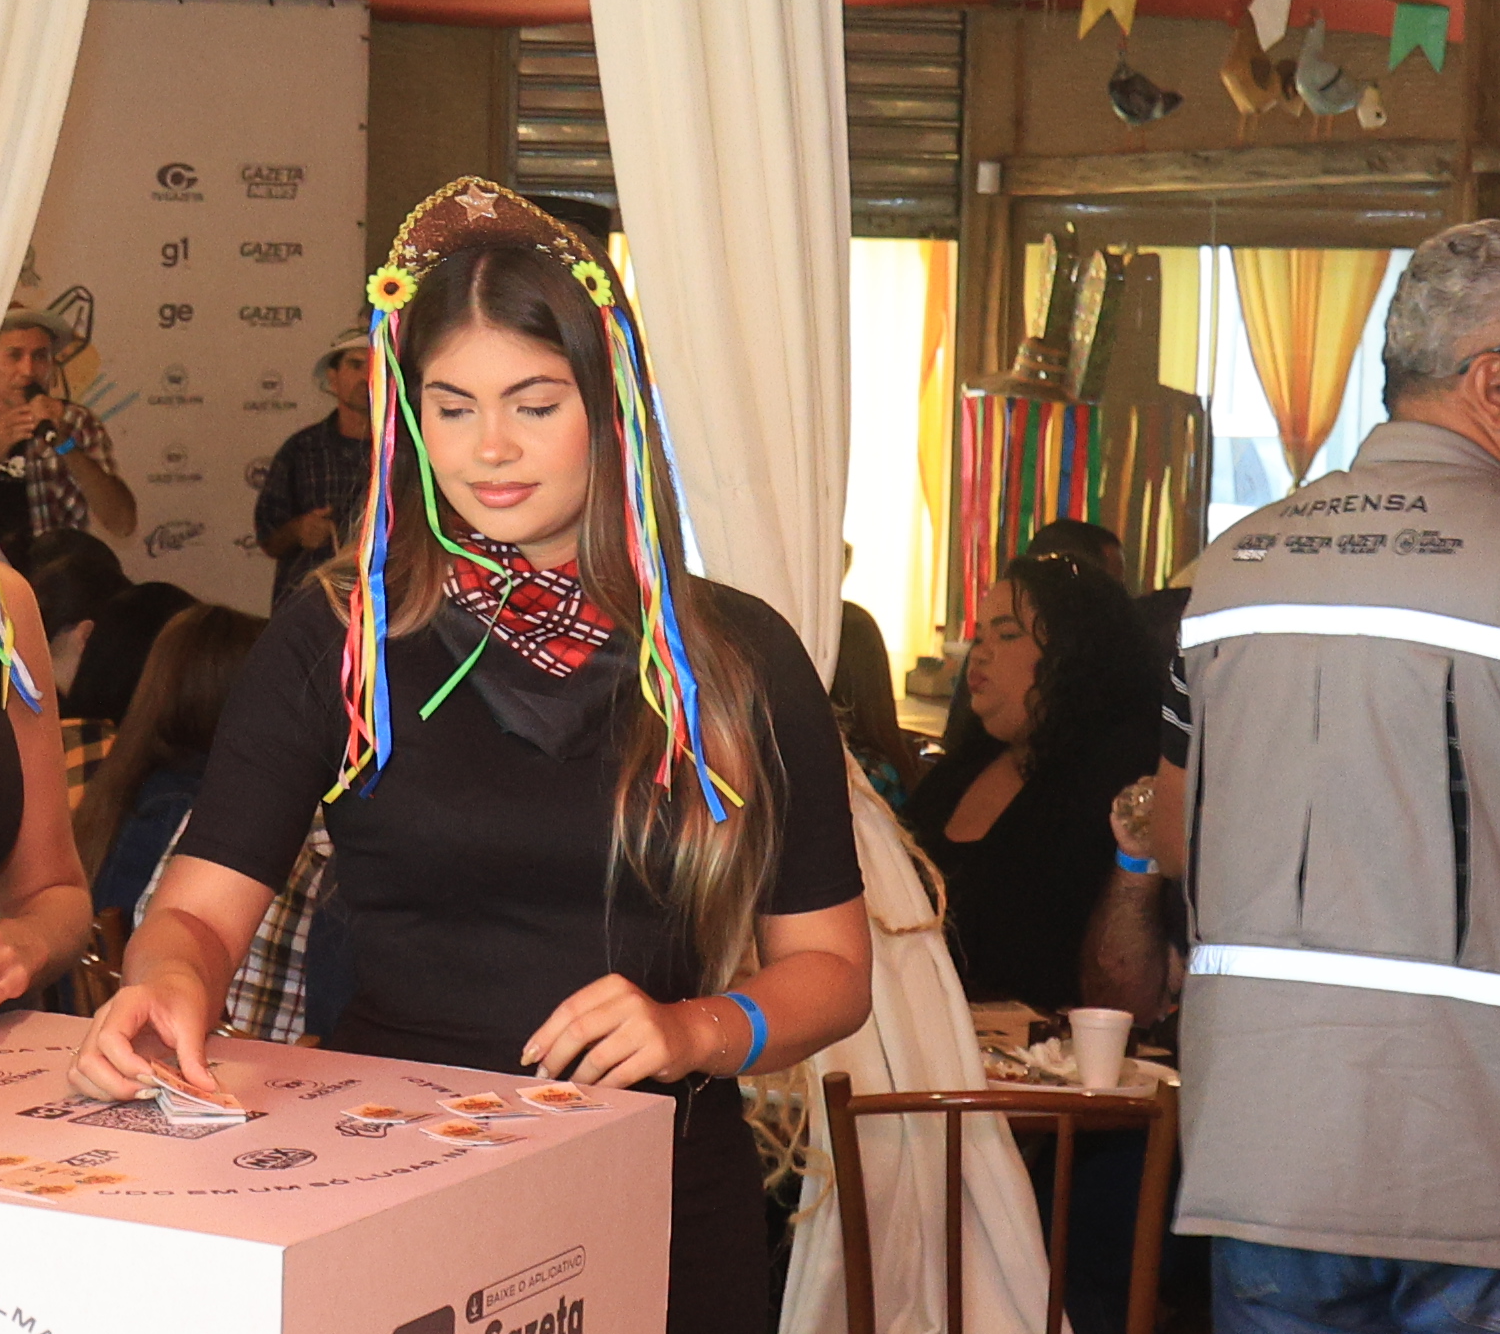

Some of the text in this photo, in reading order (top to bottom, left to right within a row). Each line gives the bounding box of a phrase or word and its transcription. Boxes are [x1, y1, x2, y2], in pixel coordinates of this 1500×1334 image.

[161, 237, 189, 268] g1
[158, 303, 194, 329] ge
[1279, 493, 1429, 518] IMPRENSA
[57, 1149, 119, 1167] ZETA
[486, 1253, 583, 1307] BAIXE O APLICATIVO
